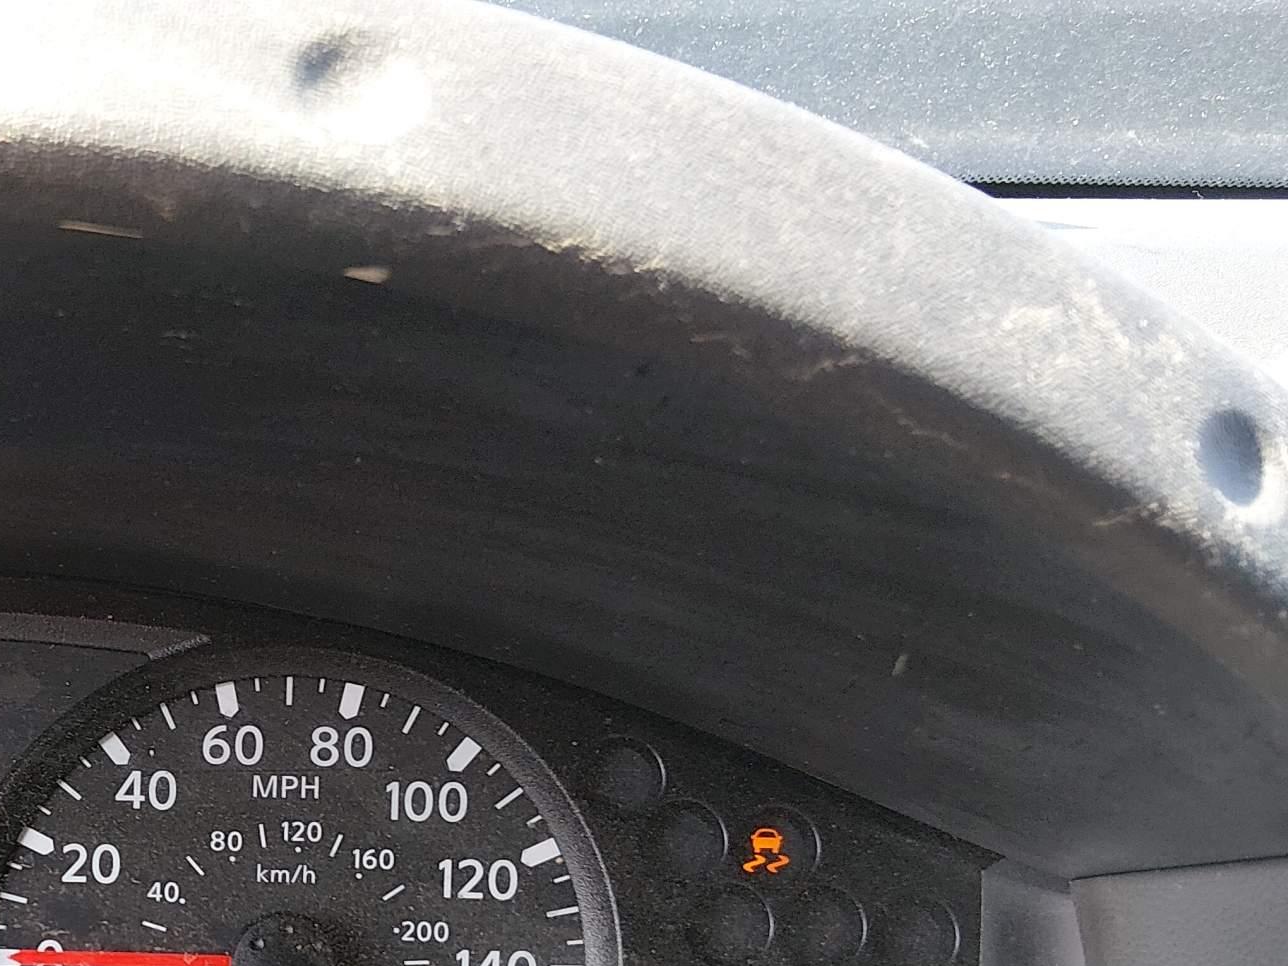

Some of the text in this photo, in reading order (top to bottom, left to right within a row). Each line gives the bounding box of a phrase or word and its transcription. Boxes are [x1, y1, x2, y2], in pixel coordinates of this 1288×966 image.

[203, 725, 263, 765] 60
[311, 727, 372, 767] 80
[115, 771, 176, 810] 40
[253, 775, 319, 799] MPH
[386, 781, 467, 822] 100
[211, 831, 242, 851] 80
[282, 822, 321, 842] 120
[62, 844, 120, 884] 20
[353, 849, 394, 869] 160
[257, 864, 315, 884] km/h
[439, 859, 517, 900] 120
[147, 882, 178, 902] 40
[402, 921, 448, 942] 200
